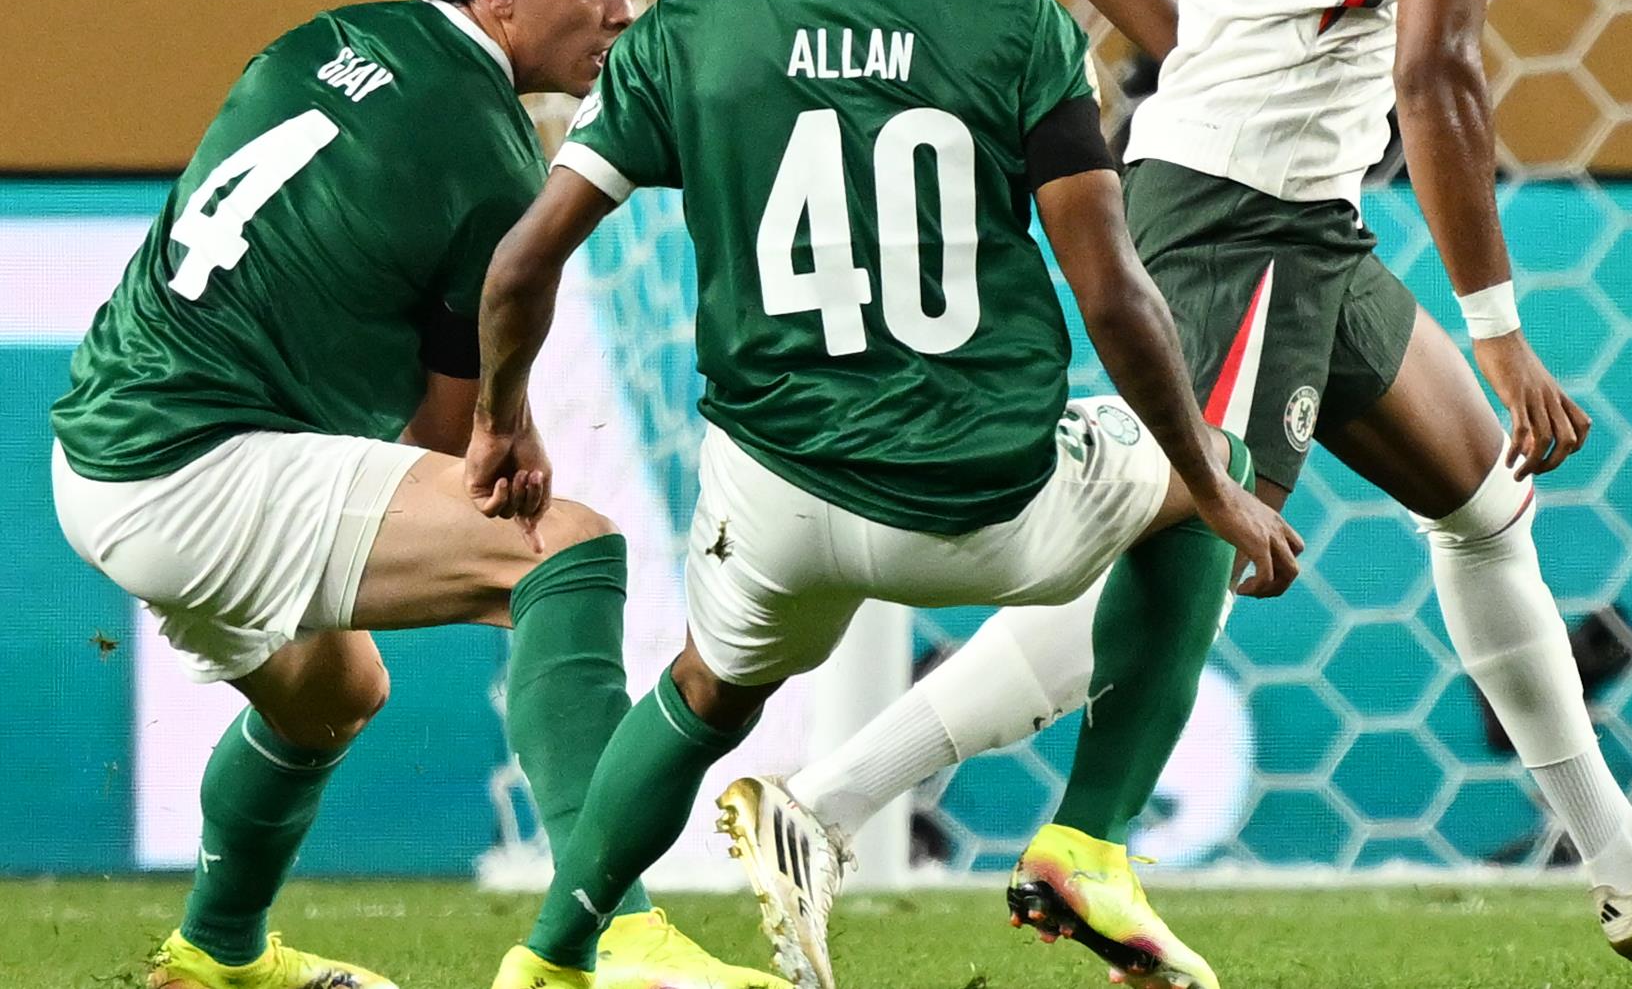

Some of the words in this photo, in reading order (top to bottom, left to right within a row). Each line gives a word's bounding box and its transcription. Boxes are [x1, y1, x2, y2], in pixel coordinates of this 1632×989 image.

[317, 46, 394, 103] GIAY
[787, 28, 915, 82] ALLAN
[168, 108, 340, 301] 4
[756, 107, 981, 357] 40
